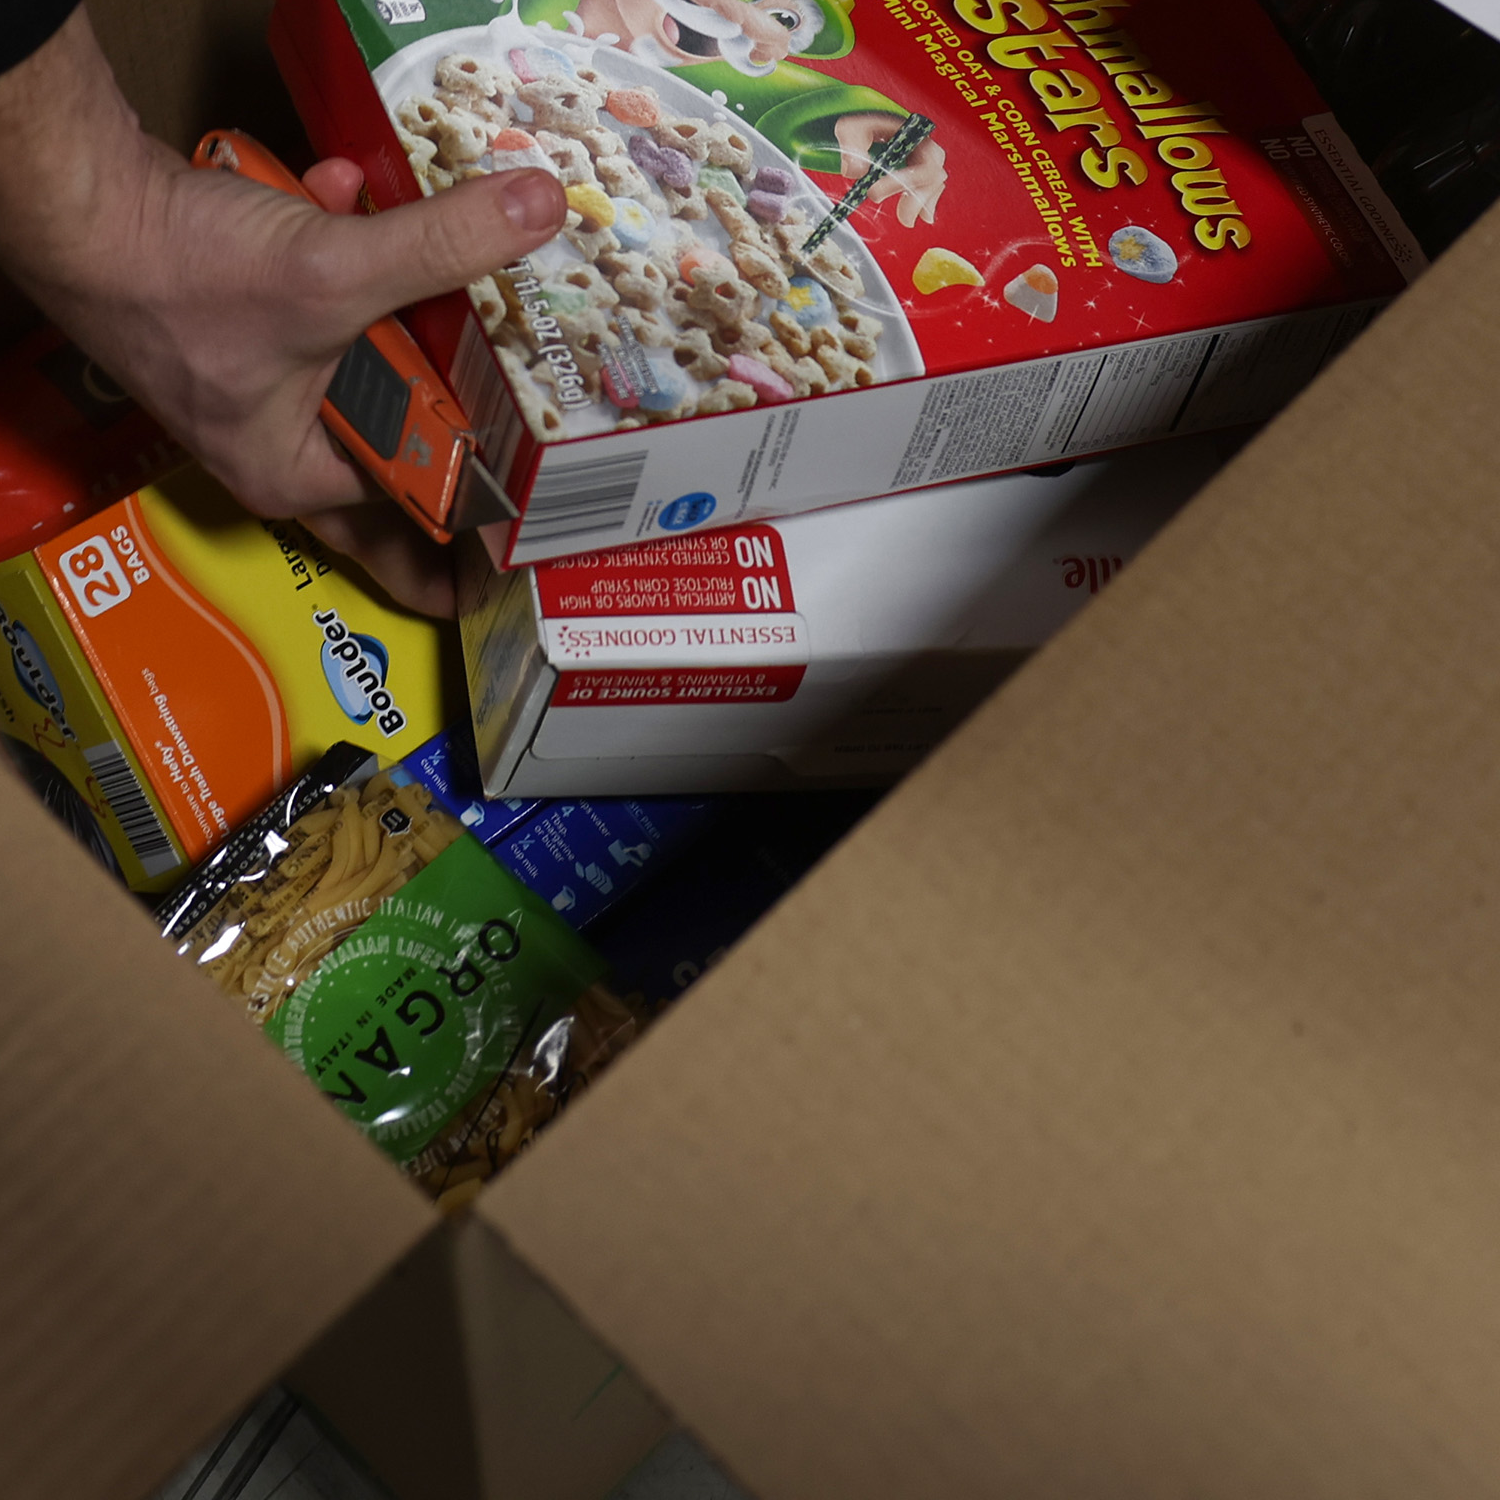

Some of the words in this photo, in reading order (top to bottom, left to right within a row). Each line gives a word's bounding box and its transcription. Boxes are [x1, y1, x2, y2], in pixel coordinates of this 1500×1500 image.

[915, 32, 986, 110] Magical
[977, 107, 1078, 271] Marshmallows
[956, 48, 992, 83] OAT
[984, 82, 1001, 98] &
[995, 97, 1037, 146] CORN
[1031, 145, 1074, 213] CEREAL
[1068, 213, 1104, 270] WITH
[1286, 136, 1317, 158] NO
[1259, 138, 1291, 160] NO
[1304, 195, 1334, 237] SYNTHETIC
[1314, 127, 1363, 194] ESSENTIAL
[1359, 194, 1406, 258] GOODNESS
[516, 276, 549, 316] 11.5
[532, 313, 560, 343] OZ
[540, 340, 591, 412] (326g)
[110, 524, 150, 583] BAGS
[670, 548, 730, 565] CERTIFIED
[708, 535, 727, 549] OR
[734, 533, 772, 567] NO
[601, 551, 669, 567] SYNTHETIC
[68, 545, 118, 605] 28
[589, 576, 630, 595] SYRUP
[633, 576, 669, 593] CORN
[672, 575, 733, 591] FRUCTOSE
[558, 593, 592, 611] HIGH
[593, 593, 612, 609] OR
[614, 589, 670, 610] FLAVORS
[671, 588, 735, 606] ARTIFICIAL
[741, 572, 781, 610] NO
[567, 626, 675, 646] GOODNESS
[679, 625, 796, 643] ESSENTIAL
[139, 667, 160, 695] bags
[312, 606, 406, 736] Boulder
[572, 674, 656, 686] MINERALS
[659, 674, 673, 685] &
[676, 673, 755, 684] VITAMINS
[756, 672, 766, 683] 8
[565, 687, 593, 700] OF
[595, 686, 672, 698] SOURCE
[675, 685, 778, 697] EXCELLENT
[152, 693, 195, 766] Drawstring
[178, 780, 191, 793] to
[187, 765, 213, 801] Trash
[420, 758, 435, 776] cup
[431, 773, 448, 794] milk
[289, 782, 326, 817] PASTA
[561, 805, 575, 818] 4
[203, 799, 232, 838] Large
[545, 811, 568, 838] Tbsp.
[580, 801, 593, 815] ups
[590, 812, 611, 837] water
[639, 815, 661, 839] PREP
[534, 824, 545, 836] or
[541, 833, 565, 862] butter
[541, 818, 575, 861] margarine
[222, 831, 277, 883] EMOLA
[510, 843, 525, 860] cup
[522, 858, 539, 879] milk
[288, 895, 372, 951] AUTHENTIC
[376, 895, 444, 928] ITALIAN
[316, 929, 390, 980] ITALIAN
[374, 966, 416, 1007] MADE
[355, 1011, 373, 1028] IN
[313, 1035, 352, 1074] ITALY
